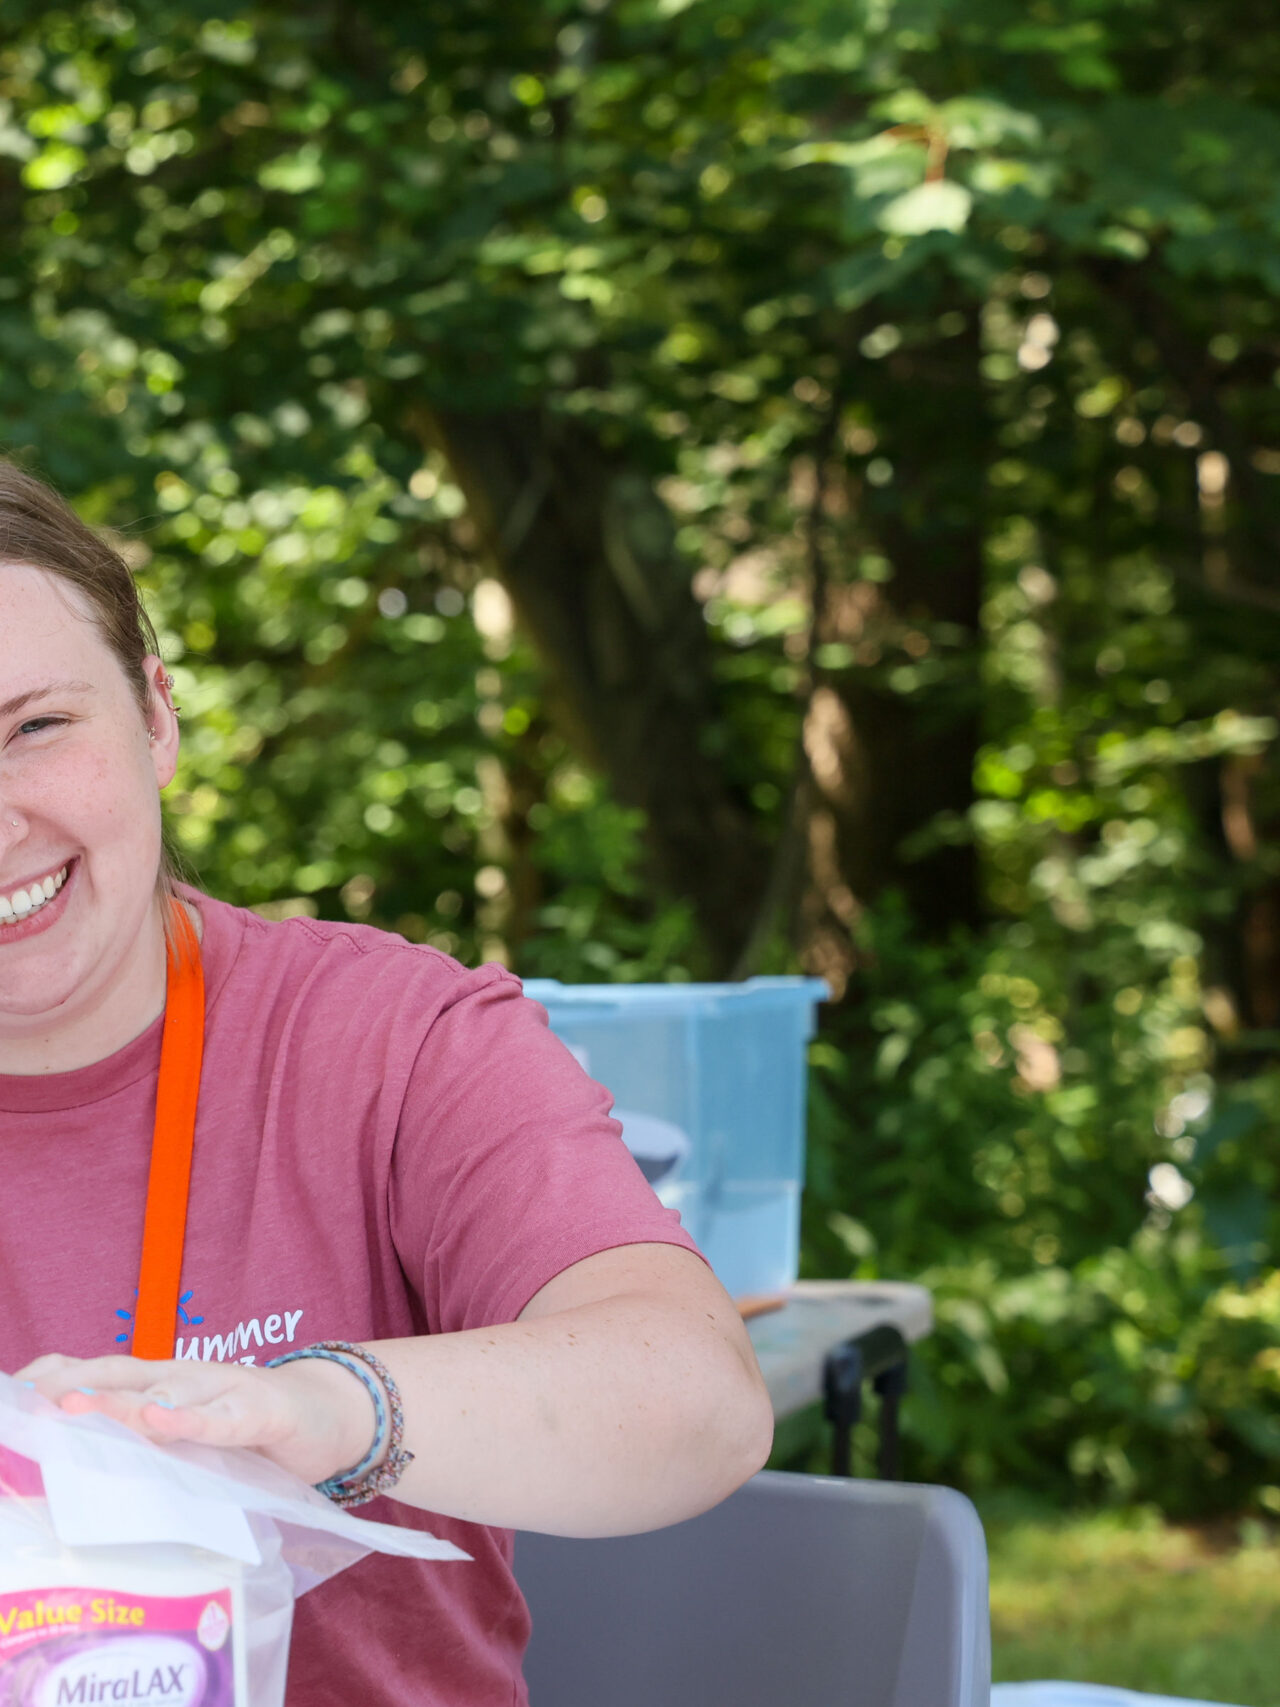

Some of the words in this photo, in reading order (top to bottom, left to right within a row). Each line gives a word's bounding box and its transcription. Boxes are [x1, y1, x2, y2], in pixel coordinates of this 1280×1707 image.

[175, 1309, 304, 1364] ummer
[90, 1598, 146, 1627] Size
[56, 1664, 185, 1705] MiraLAX
